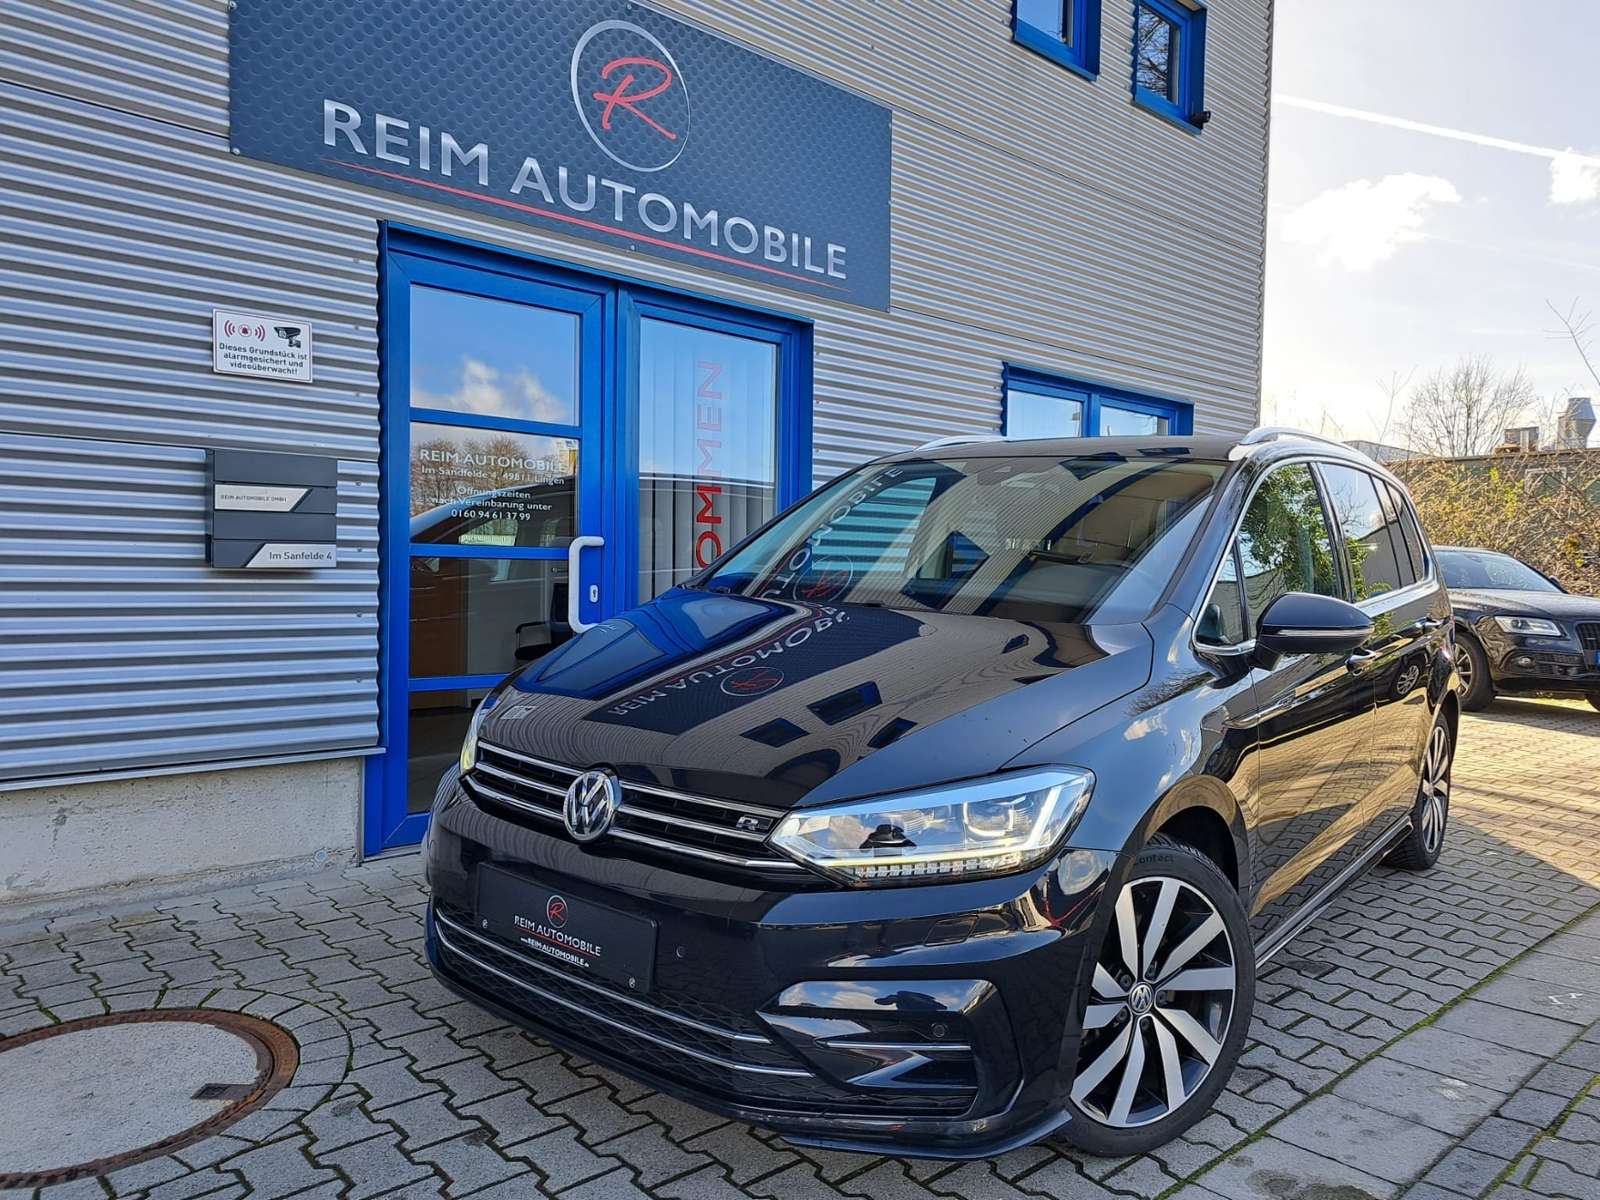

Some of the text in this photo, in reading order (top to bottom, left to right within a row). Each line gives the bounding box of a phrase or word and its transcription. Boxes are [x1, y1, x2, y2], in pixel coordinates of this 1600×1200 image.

[322, 98, 849, 281] REIM AUTOMOBILE
[219, 342, 308, 360] Dieses Grundstück ist
[223, 351, 304, 368] alarmgesichert und
[229, 361, 298, 375] videoüberwacht!
[419, 449, 570, 473] REIM AUTOMOBILE
[421, 465, 435, 474] Im
[438, 466, 488, 479] Sandfelde
[534, 474, 565, 486] Lingen
[432, 496, 553, 511] nach Vereinbarung unter
[451, 509, 531, 521] 0160 94 61 37 99
[269, 551, 333, 561] Im Sanfelde 4
[514, 915, 601, 957] REIM AUTOMOBILE
